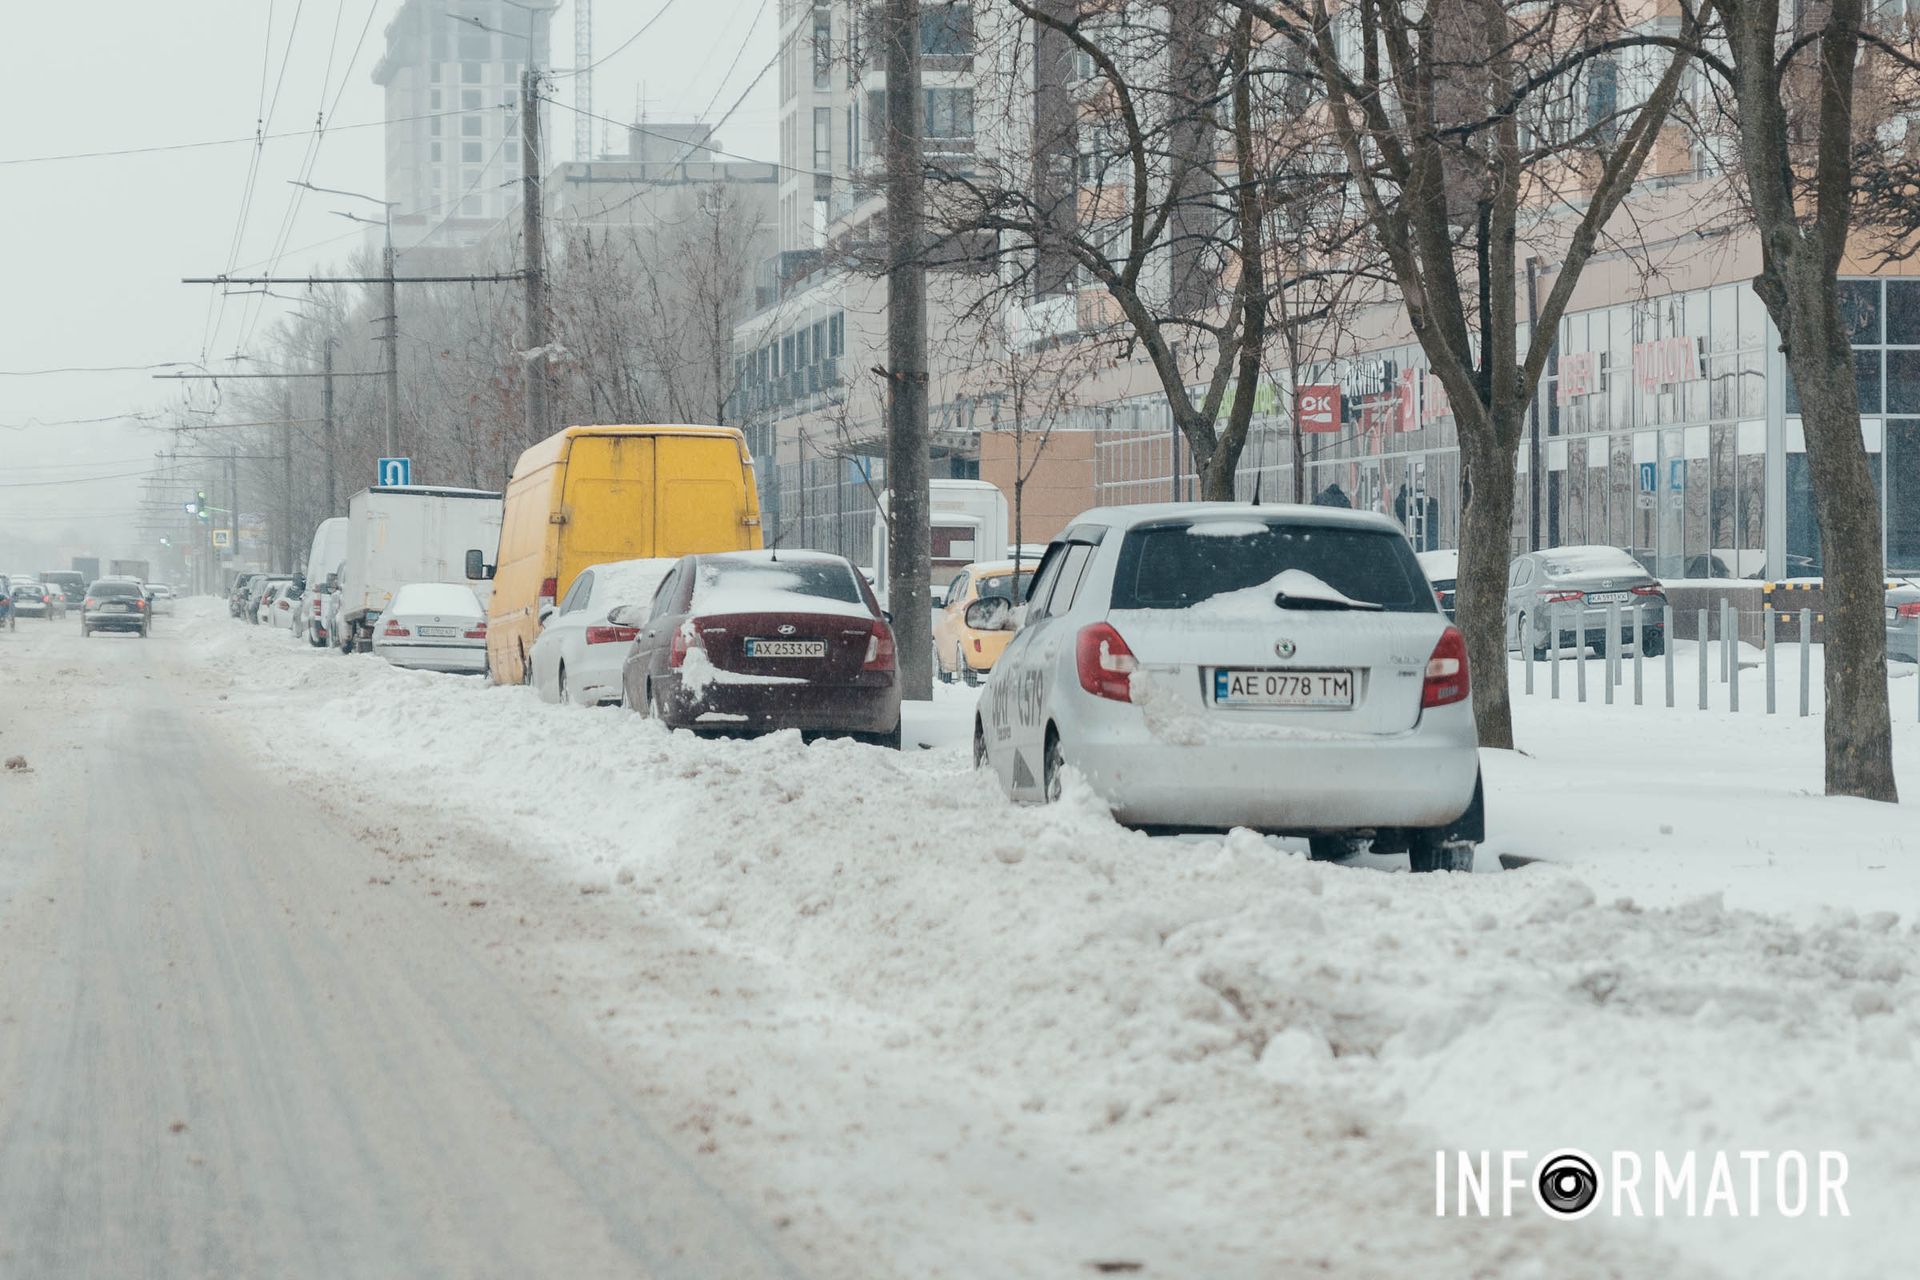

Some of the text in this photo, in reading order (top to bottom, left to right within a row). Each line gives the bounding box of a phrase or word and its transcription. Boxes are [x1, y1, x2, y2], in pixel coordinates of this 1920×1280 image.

[754, 642, 823, 655] AX 2533 KP
[1230, 676, 1348, 697] AE 0778 TM
